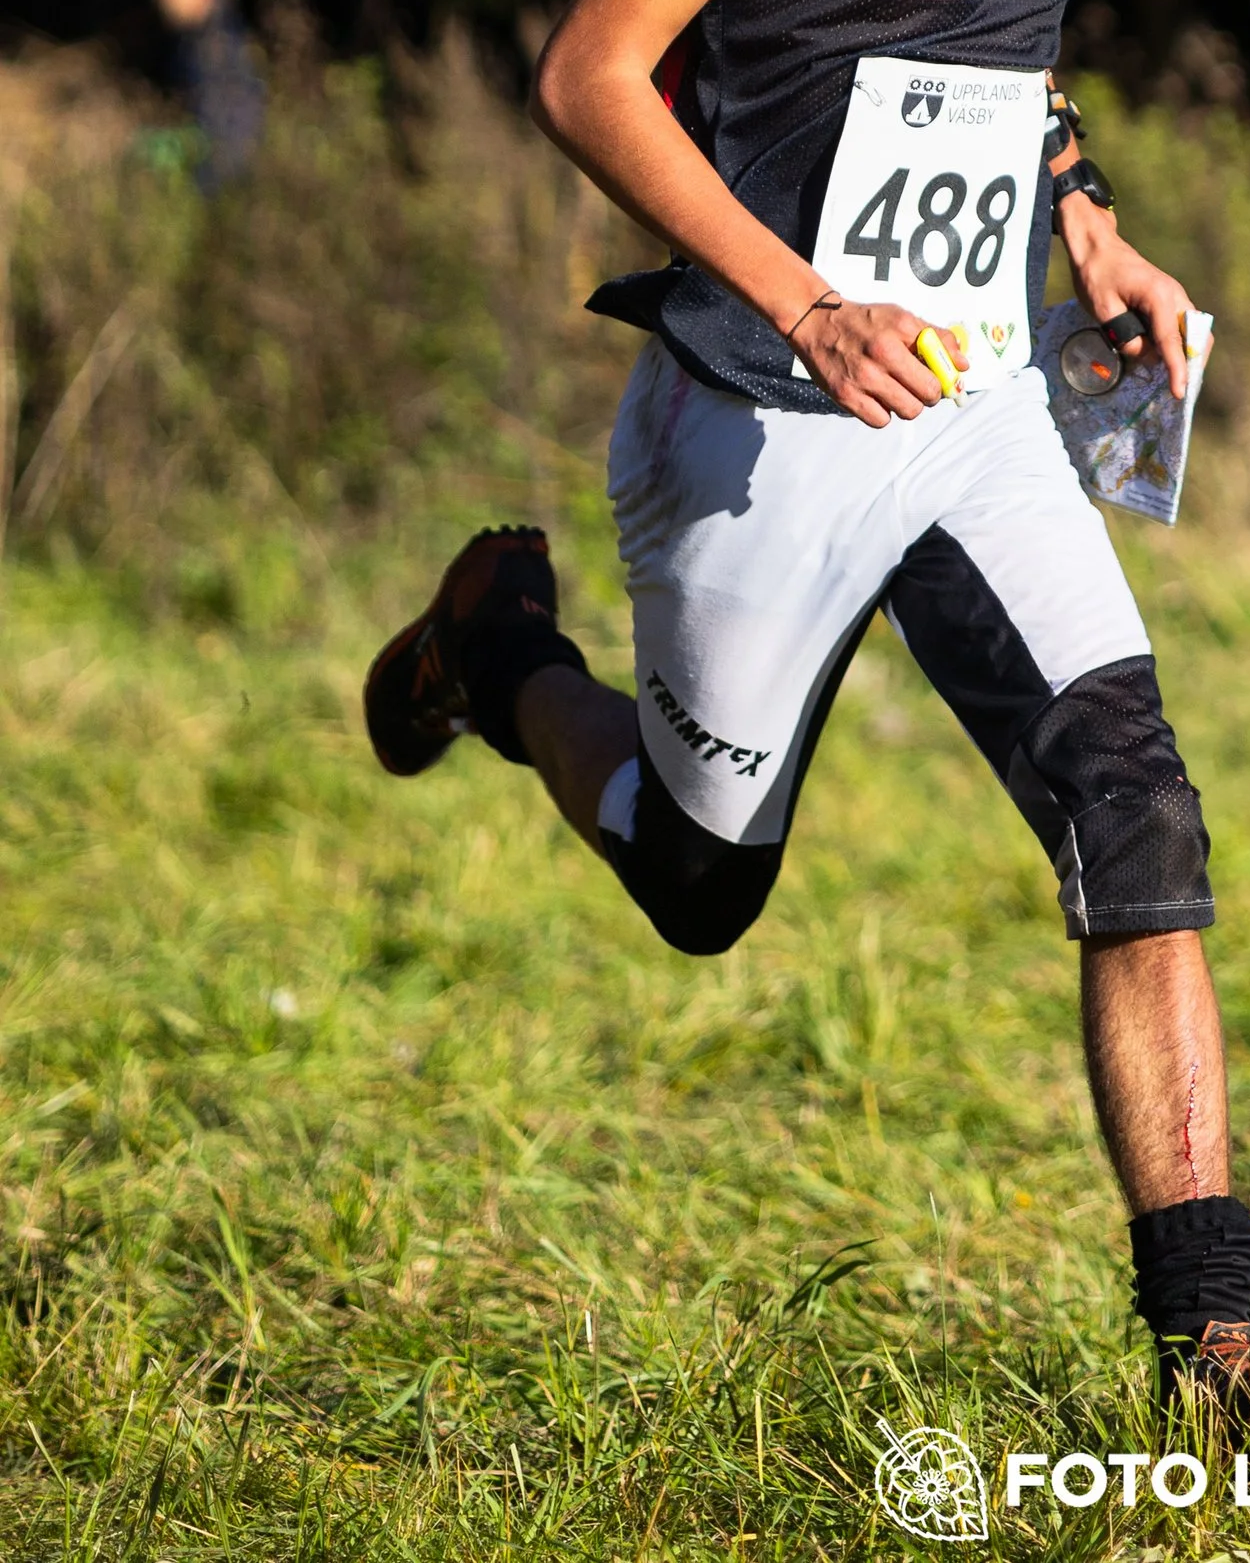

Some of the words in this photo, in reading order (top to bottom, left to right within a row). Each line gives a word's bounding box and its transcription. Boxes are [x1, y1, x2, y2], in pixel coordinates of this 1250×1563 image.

[952, 82, 1023, 101] UPPLANDS
[948, 102, 996, 125] VÄSBY
[842, 166, 1017, 288] 488
